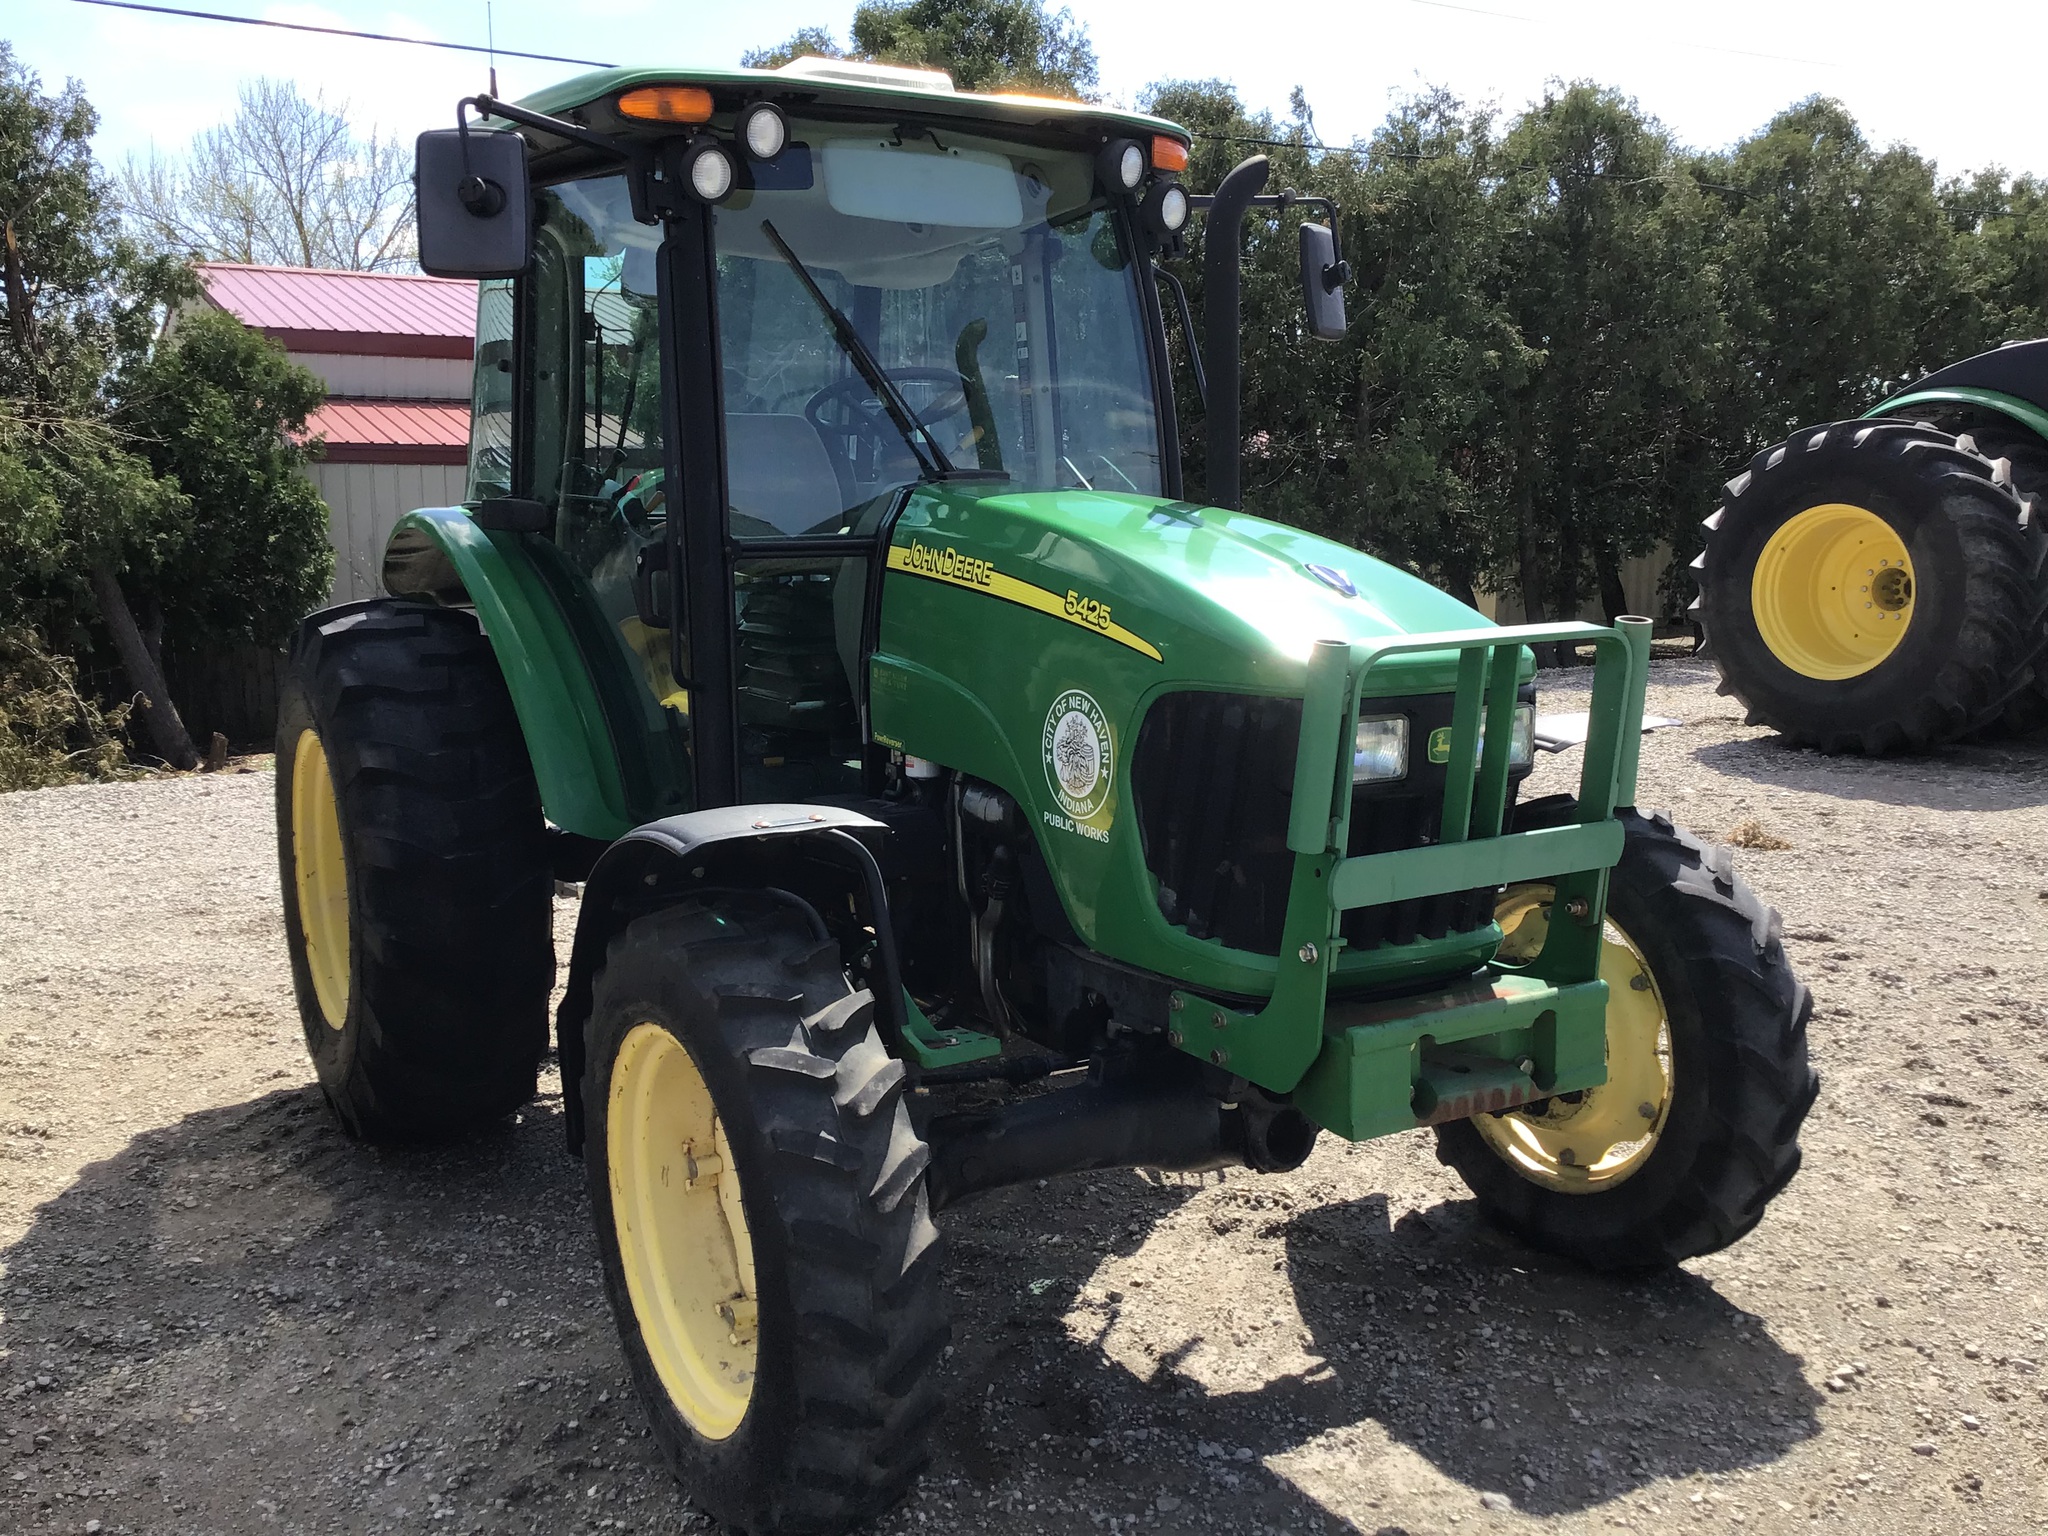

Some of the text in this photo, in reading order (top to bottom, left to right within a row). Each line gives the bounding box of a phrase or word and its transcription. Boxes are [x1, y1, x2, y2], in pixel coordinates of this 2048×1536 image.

[1064, 589, 1112, 630] 5425
[1045, 696, 1110, 763] CITY OF NEW HAVEN
[1057, 789, 1094, 814] INDIANA
[1043, 811, 1110, 844] PUBLIC WORKS
